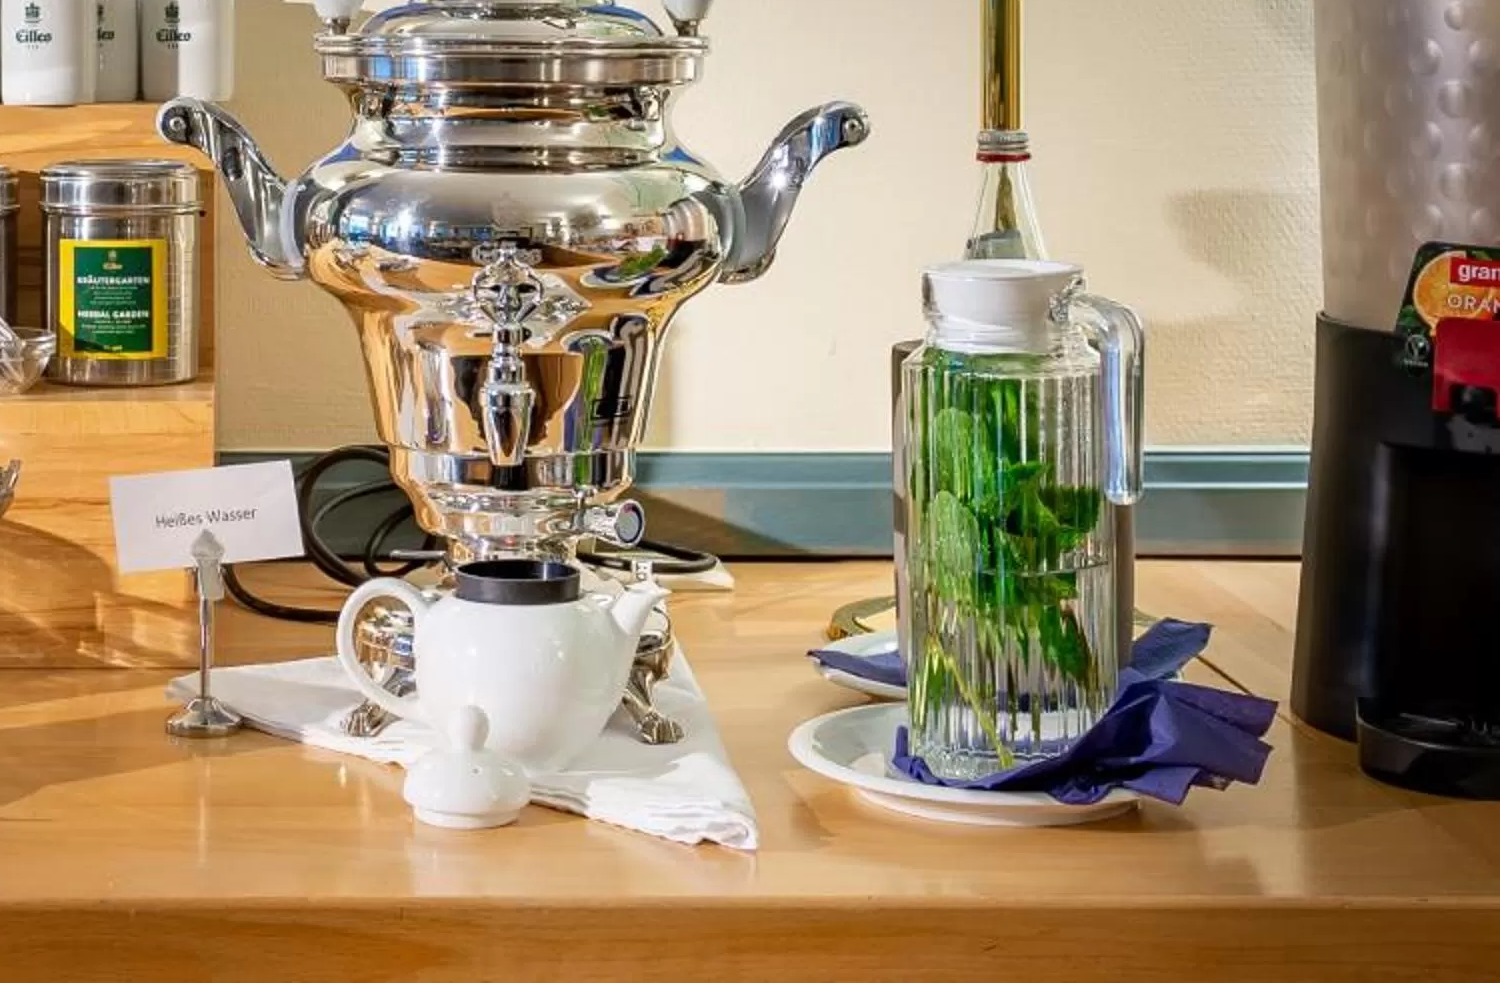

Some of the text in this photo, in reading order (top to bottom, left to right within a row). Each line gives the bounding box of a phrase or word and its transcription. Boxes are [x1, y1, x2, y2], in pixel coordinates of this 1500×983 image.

[15, 28, 52, 43] Eilles
[156, 28, 191, 43] Eilles
[77, 274, 151, 285] KRÄUTERGARTEN
[1458, 263, 1500, 282] gran
[77, 310, 150, 319] HERBAL GARDEN
[155, 508, 258, 528] Heißes Wasser
